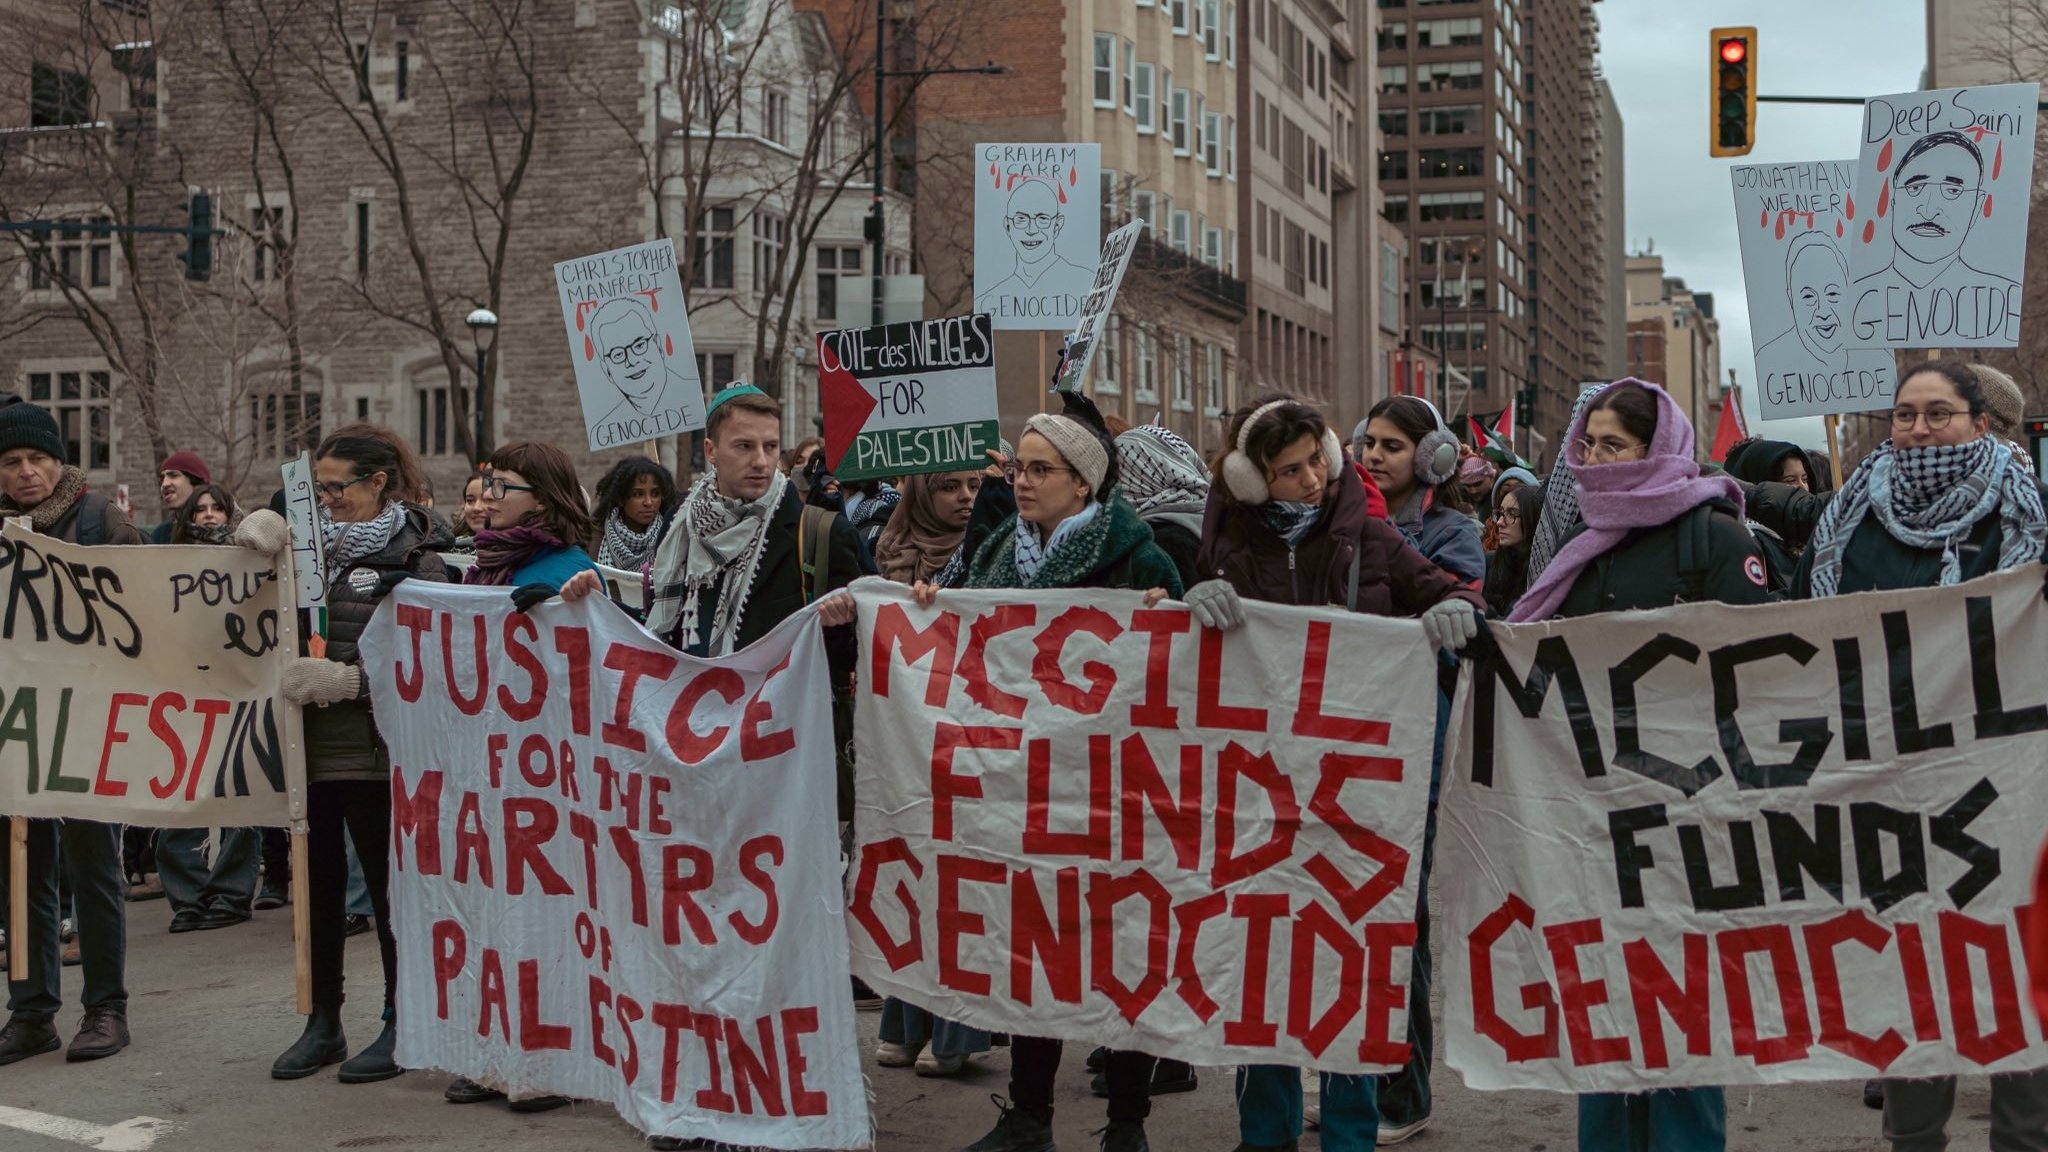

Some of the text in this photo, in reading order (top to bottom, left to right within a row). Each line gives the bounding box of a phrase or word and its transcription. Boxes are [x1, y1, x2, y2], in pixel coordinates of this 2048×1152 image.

[1950, 89, 2022, 137] Saini
[984, 145, 1077, 165] GRAHAM
[1006, 163, 1063, 179] CARR
[1735, 161, 1852, 193] JONATHAN
[1759, 192, 1844, 216] WENER
[561, 244, 676, 284] CHRISTOPHER
[567, 271, 664, 304] MANFREDI
[1852, 284, 2021, 343] GENOCIDE
[879, 379, 926, 419] FOR
[1766, 368, 1893, 406] GENOCIDE
[596, 404, 700, 447] GENOCIDE
[856, 423, 986, 470] PALESTINE
[395, 603, 797, 764] JUSTICE
[870, 602, 1393, 747] MCGILL
[1471, 594, 2048, 799] MCGILL
[0, 686, 285, 802] ALESTIN
[487, 733, 673, 836] FOR THE
[930, 720, 1411, 925] FUNDS
[1608, 776, 2002, 915] FUNDS
[391, 765, 785, 946] MARTYRS
[574, 911, 613, 973] OF
[848, 836, 1419, 1066] GENOCIDE
[1468, 891, 2048, 1072] GENOCID
[432, 919, 829, 1118] PALESTINE
